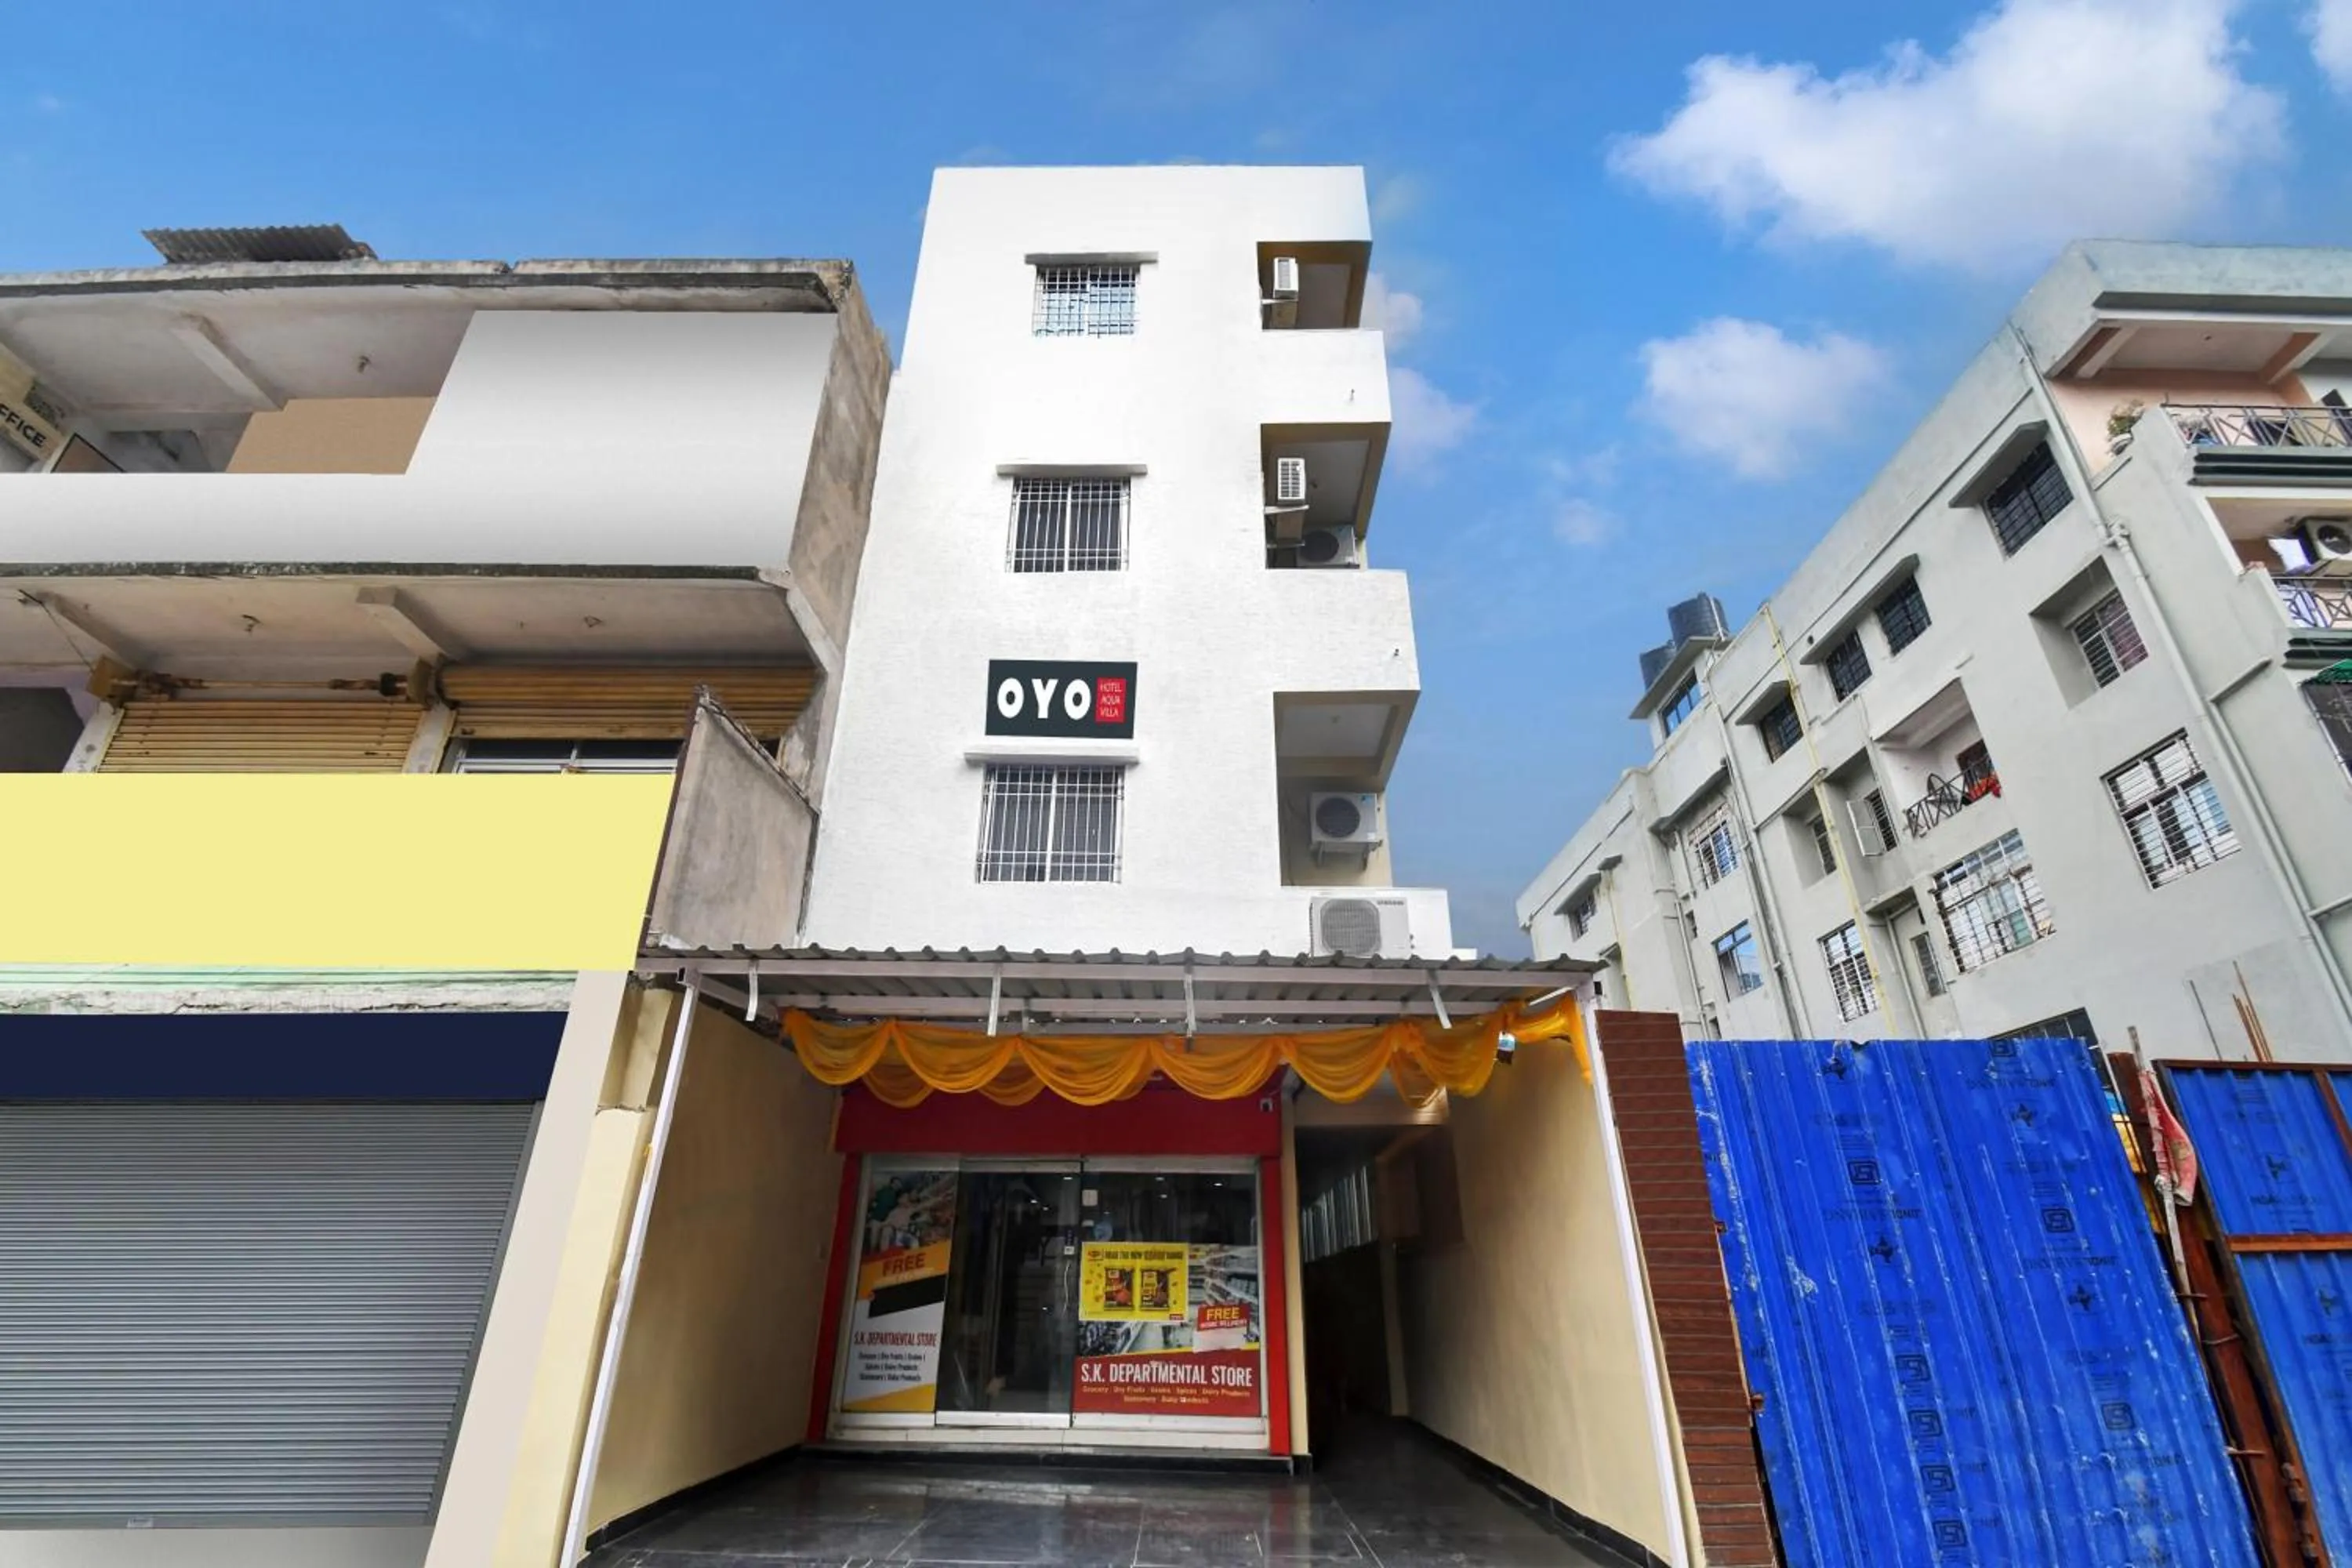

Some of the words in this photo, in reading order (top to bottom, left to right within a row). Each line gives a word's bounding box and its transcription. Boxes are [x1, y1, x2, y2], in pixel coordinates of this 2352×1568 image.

[997, 677, 1091, 720] OYO
[1100, 682, 1122, 692] HOTEL
[883, 1252, 926, 1277] FREE
[1207, 1306, 1240, 1321] FREE
[1081, 1363, 1105, 1383] S.K.
[1109, 1363, 1207, 1384] DEPARTMENTAL
[1211, 1365, 1252, 1387] STORE
